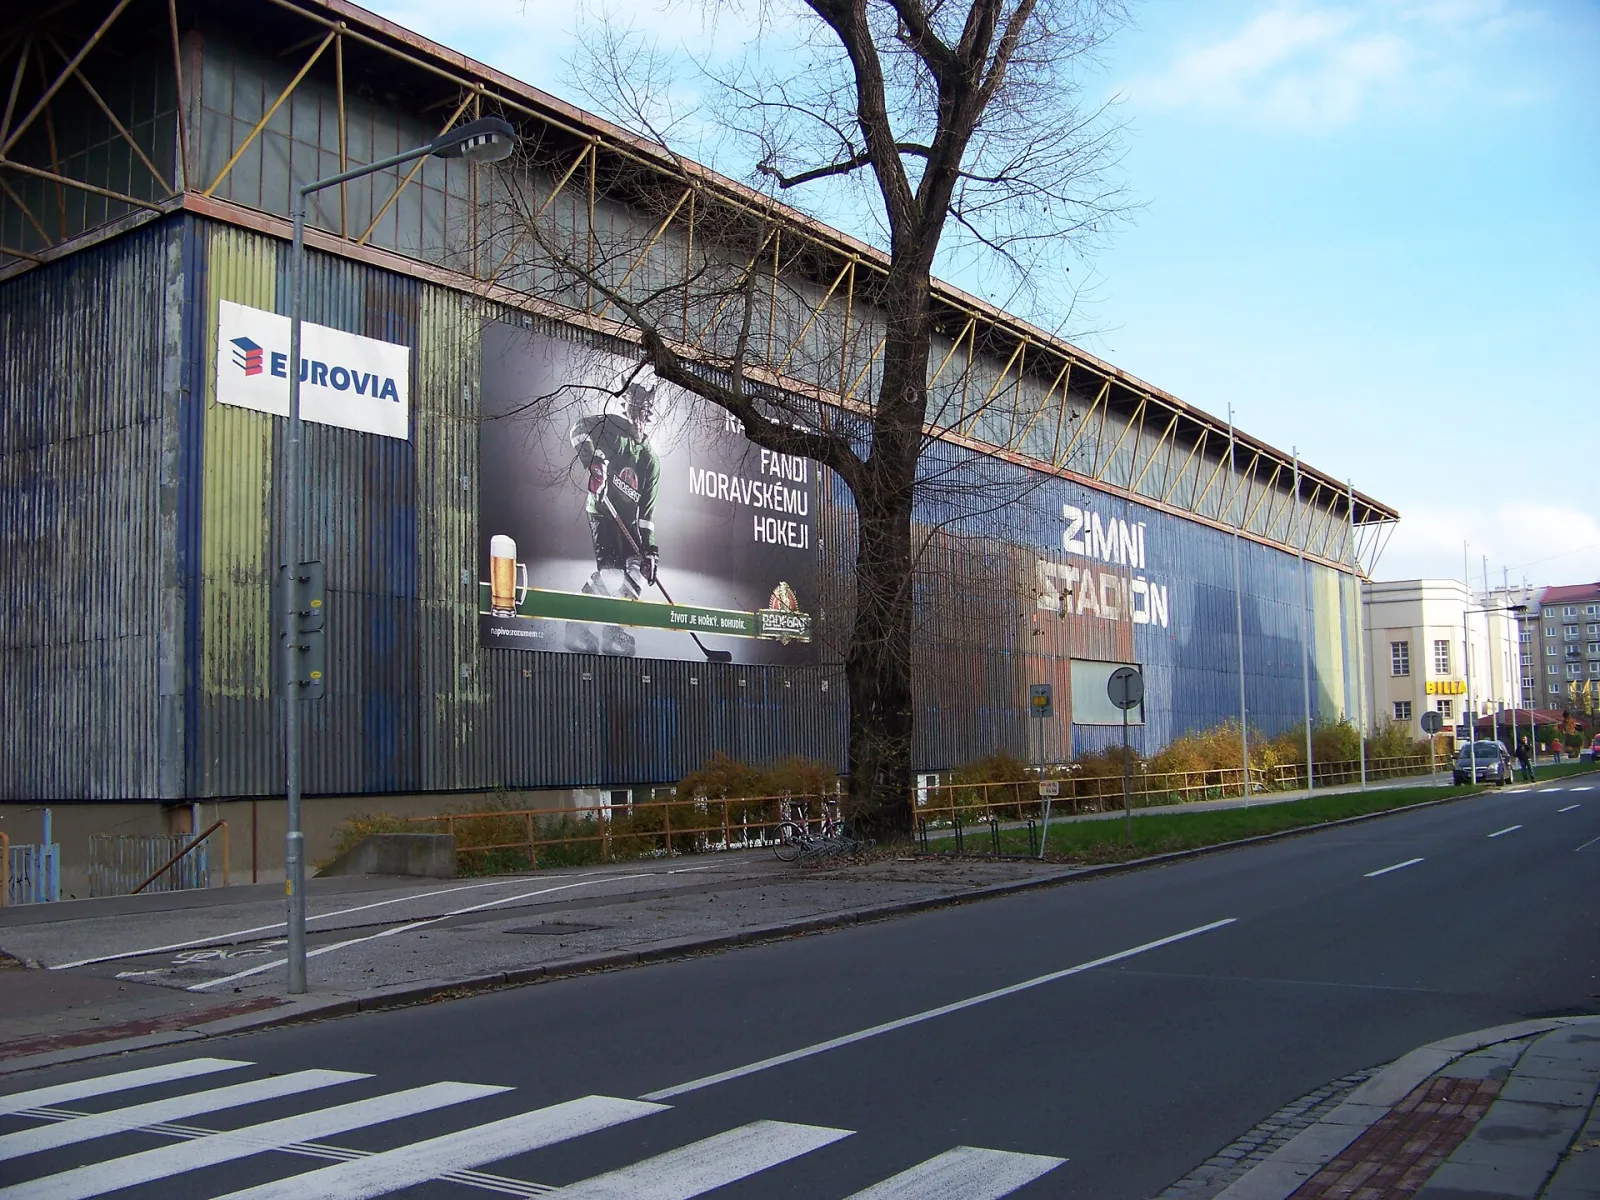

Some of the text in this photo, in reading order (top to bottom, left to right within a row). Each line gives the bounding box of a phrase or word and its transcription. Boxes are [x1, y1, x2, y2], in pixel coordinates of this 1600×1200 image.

[689, 466, 809, 516] MORAVSKÉMU
[753, 515, 809, 549] HOKEJI
[1062, 503, 1147, 569] ZIMNÍ
[670, 610, 688, 624] ŽIVOT
[689, 614, 697, 625] JE
[1425, 680, 1467, 695] BILLA
